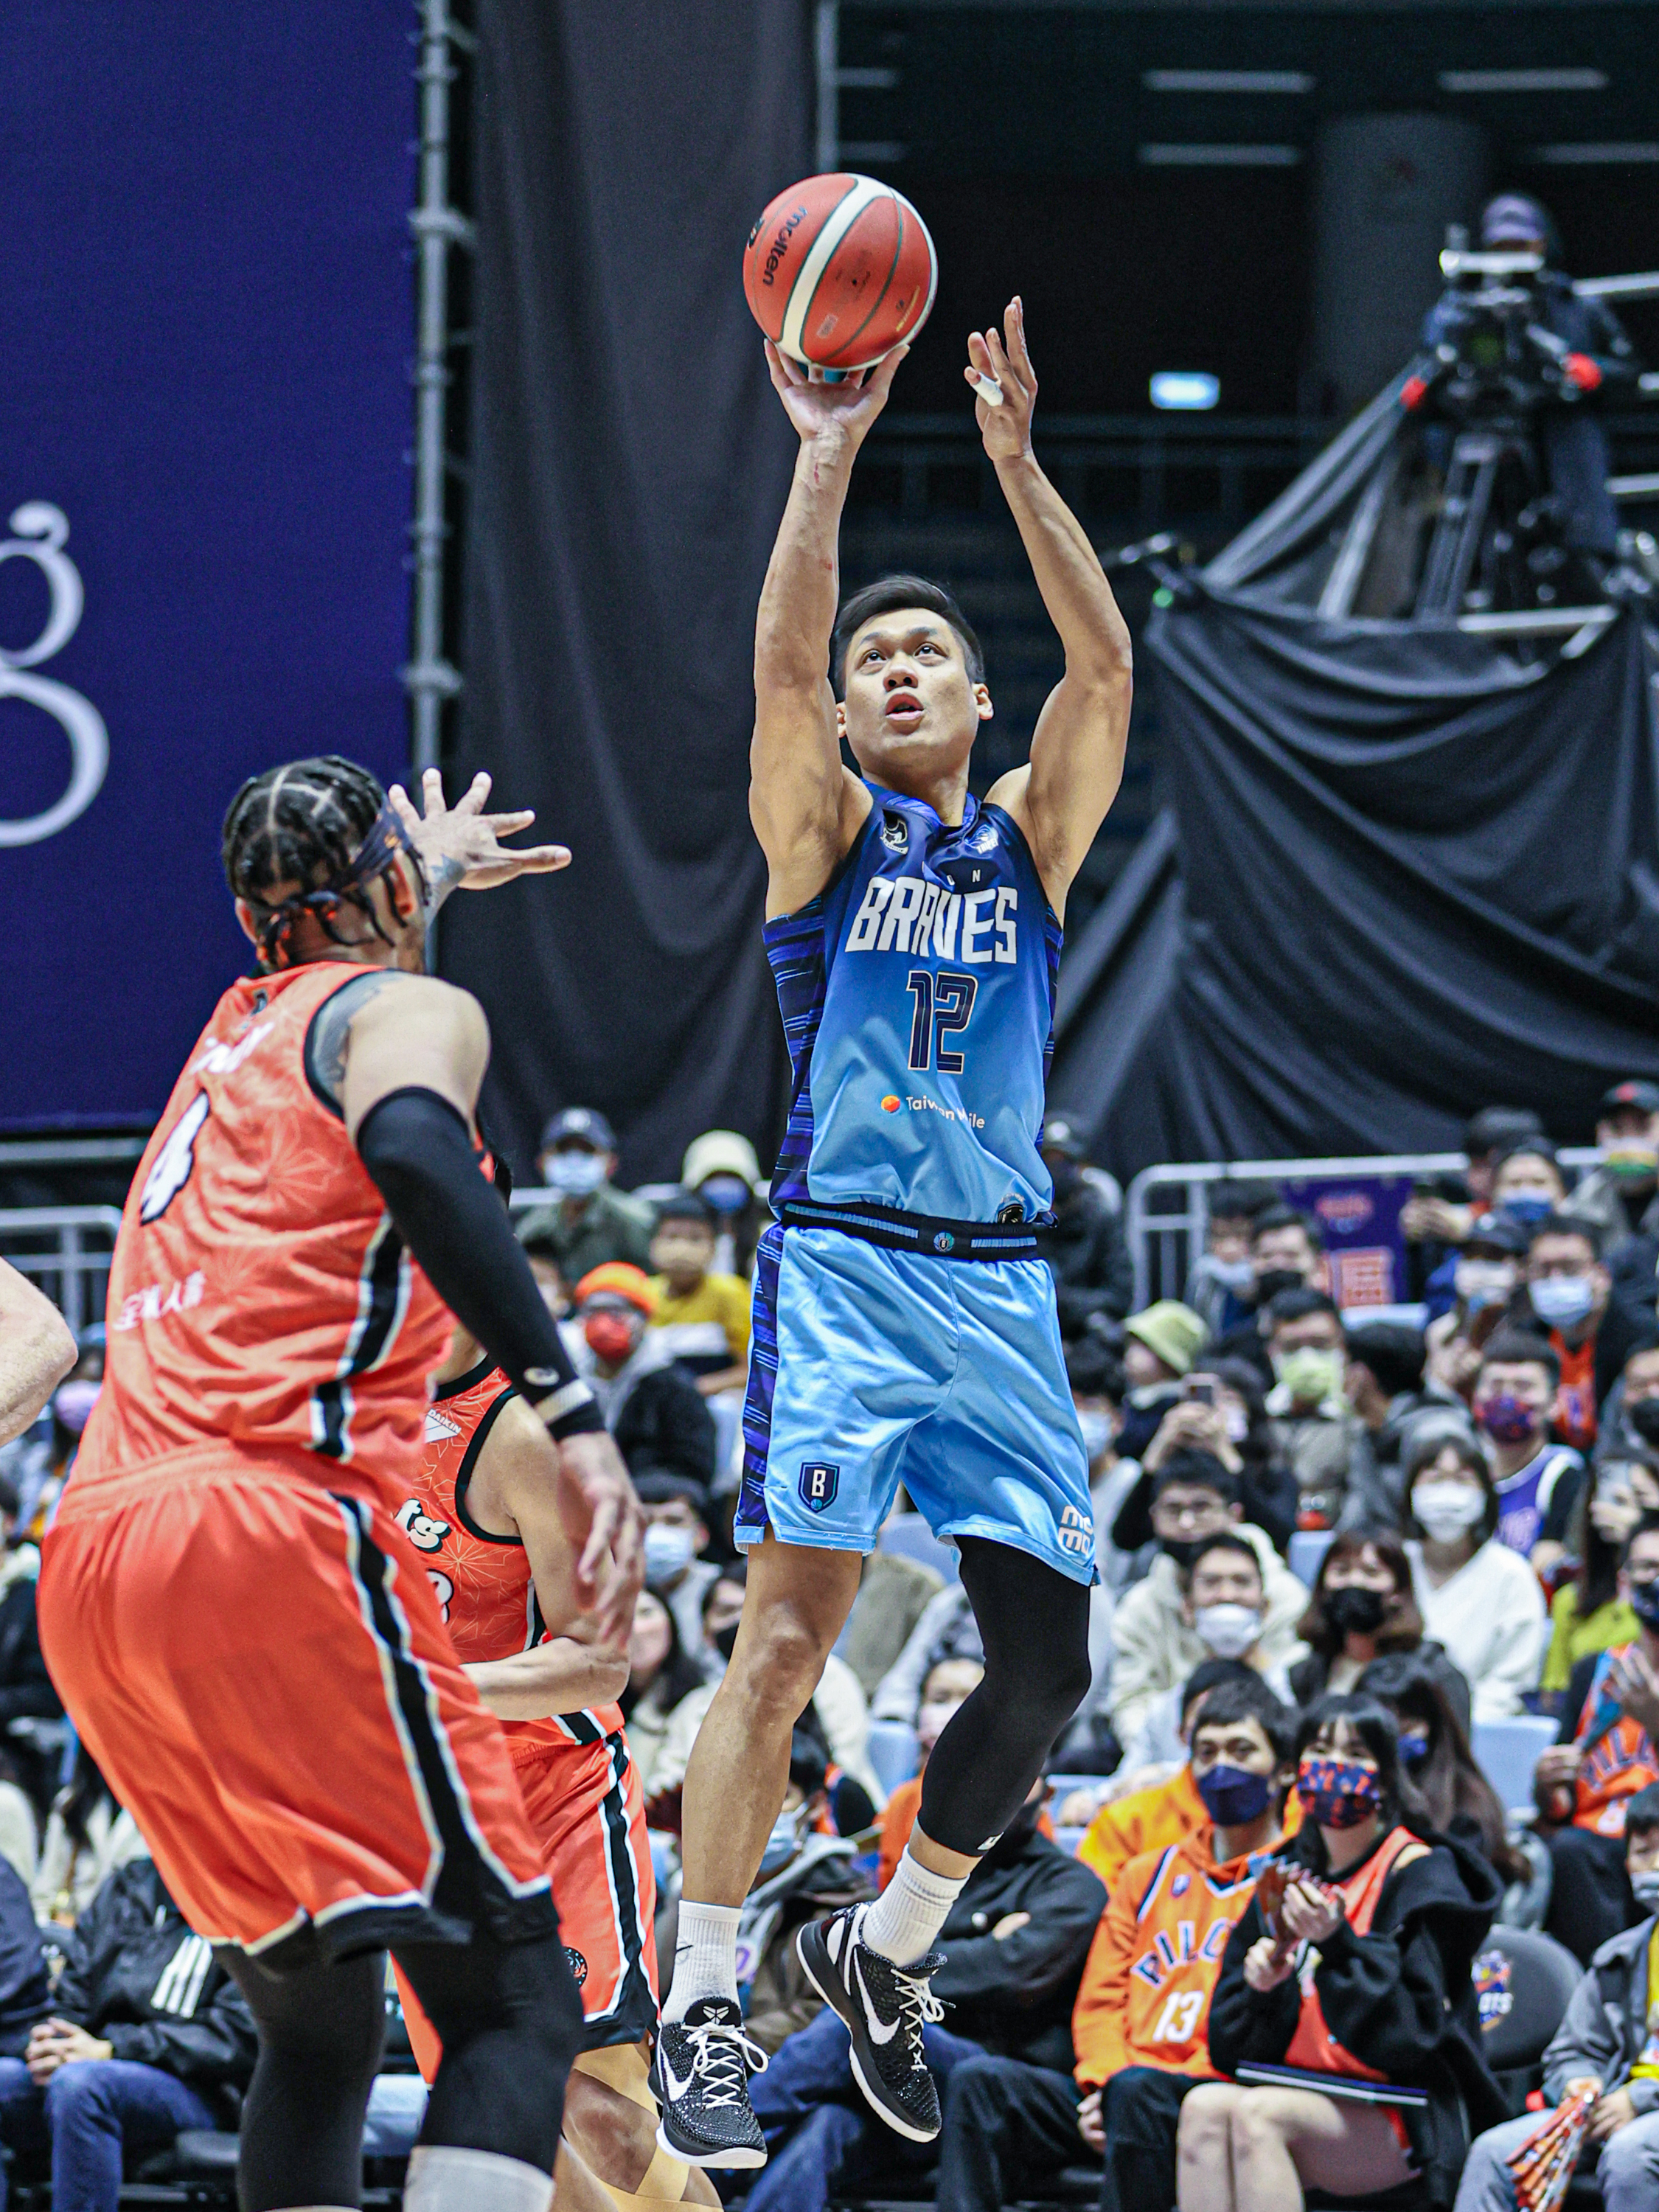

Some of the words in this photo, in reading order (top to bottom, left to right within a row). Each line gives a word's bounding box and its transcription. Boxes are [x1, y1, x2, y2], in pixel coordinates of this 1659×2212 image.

[762, 206, 808, 286] molten
[845, 876, 1018, 964] BRAVES
[905, 970, 978, 1074] 12
[905, 1095, 956, 1121] Taiwan
[956, 1107, 985, 1129] Mile
[427, 1408, 462, 1434] DAIKIN
[811, 1469, 827, 1498] B
[394, 1499, 452, 1554] ts
[1152, 1991, 1205, 2044] 13
